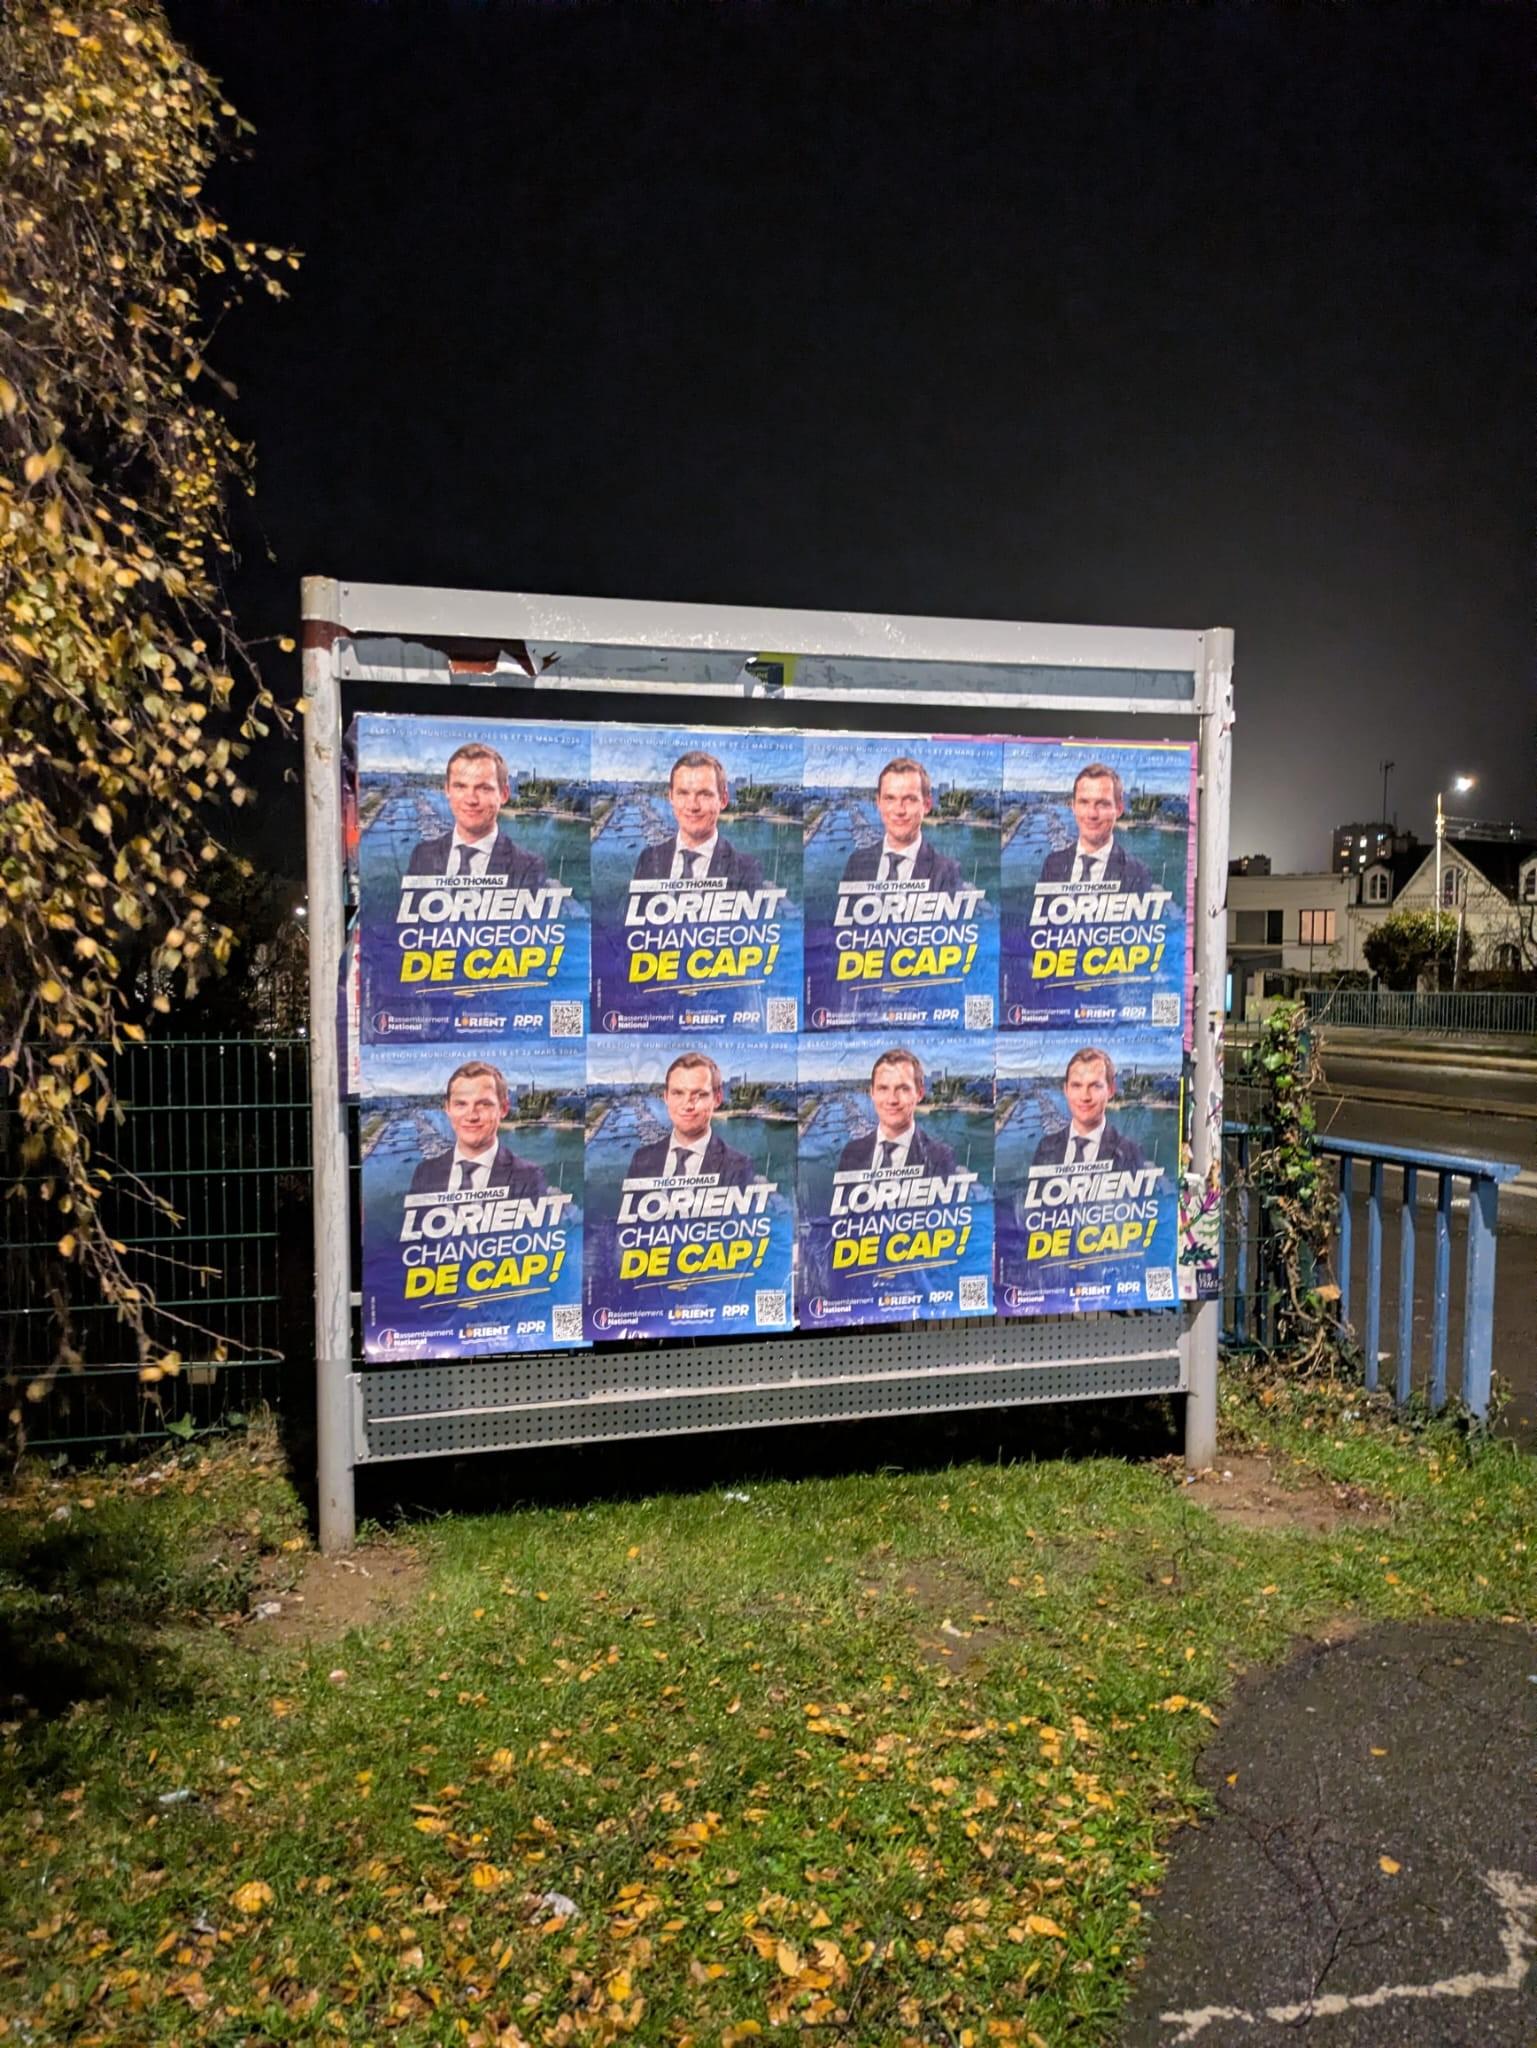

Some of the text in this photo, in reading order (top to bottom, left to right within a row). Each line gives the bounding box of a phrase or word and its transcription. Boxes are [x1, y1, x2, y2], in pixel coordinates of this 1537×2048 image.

[463, 877, 504, 885] THOMAS
[686, 880, 723, 889] THOMAS
[891, 882, 926, 890] THOMAS
[1084, 883, 1117, 891] THOMAS
[396, 888, 572, 923] LORIENT
[625, 888, 787, 926] LORIENT
[834, 890, 985, 926] LORIENT
[1029, 892, 1172, 926] LORIENT
[399, 925, 565, 949] CHANGEONS
[627, 924, 780, 951] CHANGEONS
[836, 925, 978, 950] CHANGEONS
[1031, 924, 1166, 949] CHANGEONS
[400, 950, 457, 983] DE
[628, 951, 680, 983] DE
[836, 949, 885, 981] DE
[1031, 949, 1078, 979] DE
[388, 1015, 450, 1024] Rassemblement
[513, 1015, 543, 1027] RPR
[618, 1021, 649, 1029] National
[733, 1011, 760, 1024] RPR
[933, 1009, 959, 1020] RPR
[1021, 1014, 1049, 1022] National
[388, 1023, 422, 1031] National
[678, 1176, 716, 1185] THOMAS
[885, 1168, 921, 1177] THOMAS
[465, 1189, 504, 1199] THOMAS
[830, 1173, 978, 1216] LORIENT
[1024, 1168, 1165, 1209] LORIENT
[617, 1183, 778, 1224] LORIENT
[400, 1194, 572, 1242] LORIENT
[832, 1207, 972, 1239] CHANGEONS
[1025, 1200, 1158, 1232] CHANGEONS
[619, 1217, 771, 1248] CHANGEONS
[1027, 1229, 1072, 1260] DE
[402, 1230, 566, 1266] CHANGEONS
[833, 1236, 880, 1269] DE
[619, 1247, 671, 1280] DE
[404, 1263, 461, 1299] DE
[1117, 1282, 1140, 1293] RPR
[823, 1305, 851, 1313] National
[929, 1291, 953, 1303] RPR
[608, 1310, 663, 1318] Rassemblement
[608, 1317, 638, 1325] National
[722, 1304, 749, 1317] RPR
[394, 1329, 454, 1339] Rassemblement
[517, 1321, 545, 1333] RPR
[394, 1338, 427, 1346] National
